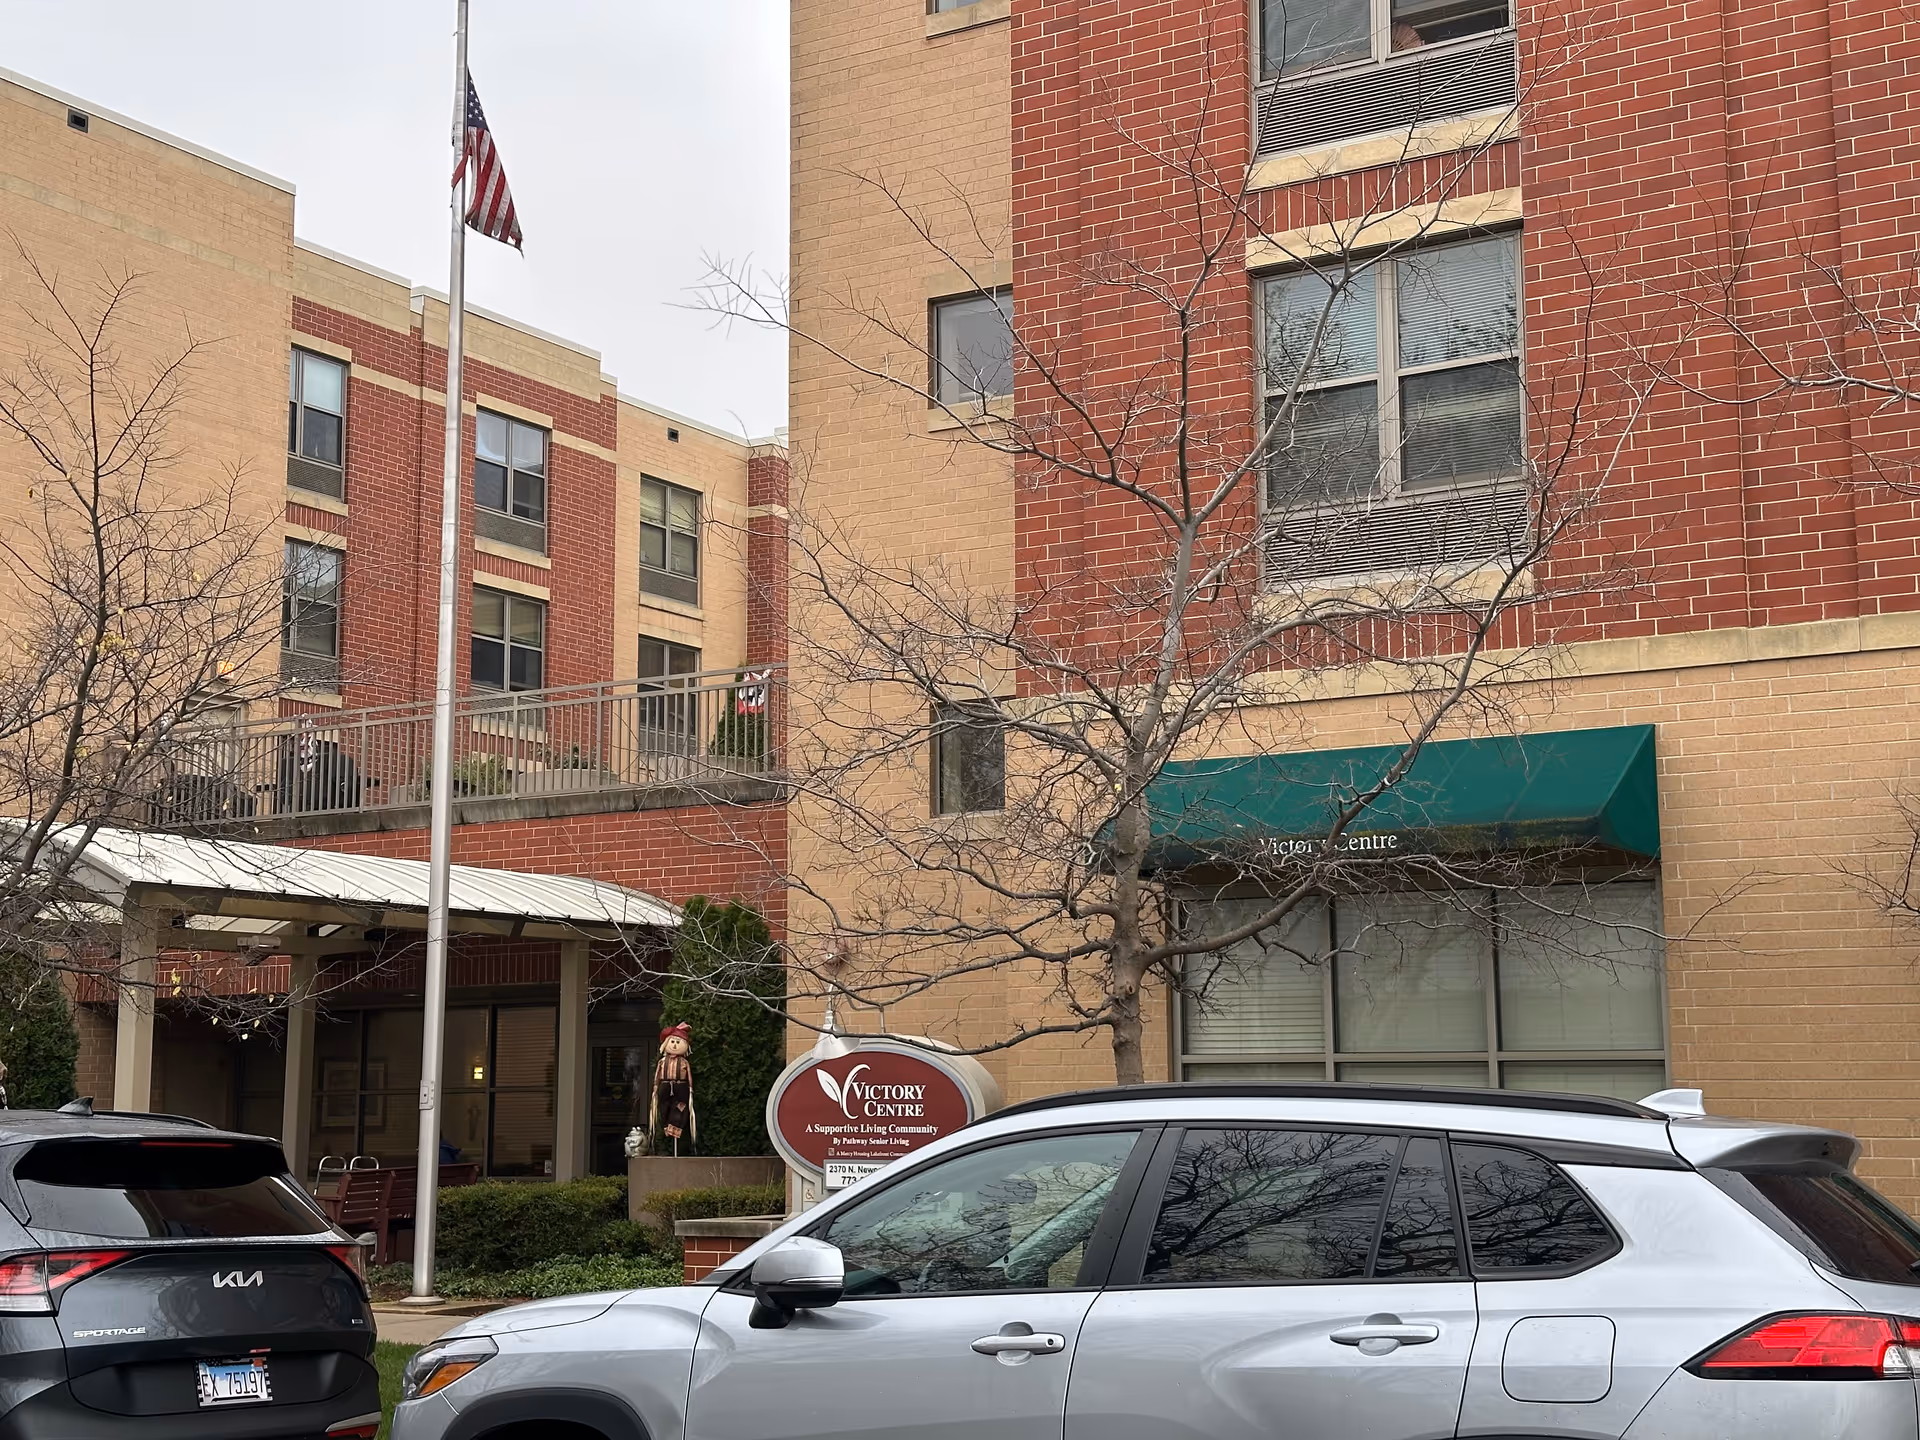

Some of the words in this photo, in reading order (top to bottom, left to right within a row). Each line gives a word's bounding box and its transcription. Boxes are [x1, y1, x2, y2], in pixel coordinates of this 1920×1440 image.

[1334, 832, 1398, 852] Centre
[852, 1082, 926, 1100] VICTORY
[864, 1100, 925, 1117] CENTRE
[805, 1124, 813, 1133] A
[814, 1124, 859, 1135] Supportive
[860, 1124, 887, 1135] Living
[888, 1124, 939, 1136] Community
[842, 1138, 868, 1146] Pathway
[889, 1138, 910, 1146] Living
[829, 1165, 847, 1173] 2370
[848, 1165, 856, 1173] N.
[73, 1327, 146, 1338] SPORTAGE
[201, 1373, 219, 1397] EX
[225, 1370, 263, 1395] 75197
